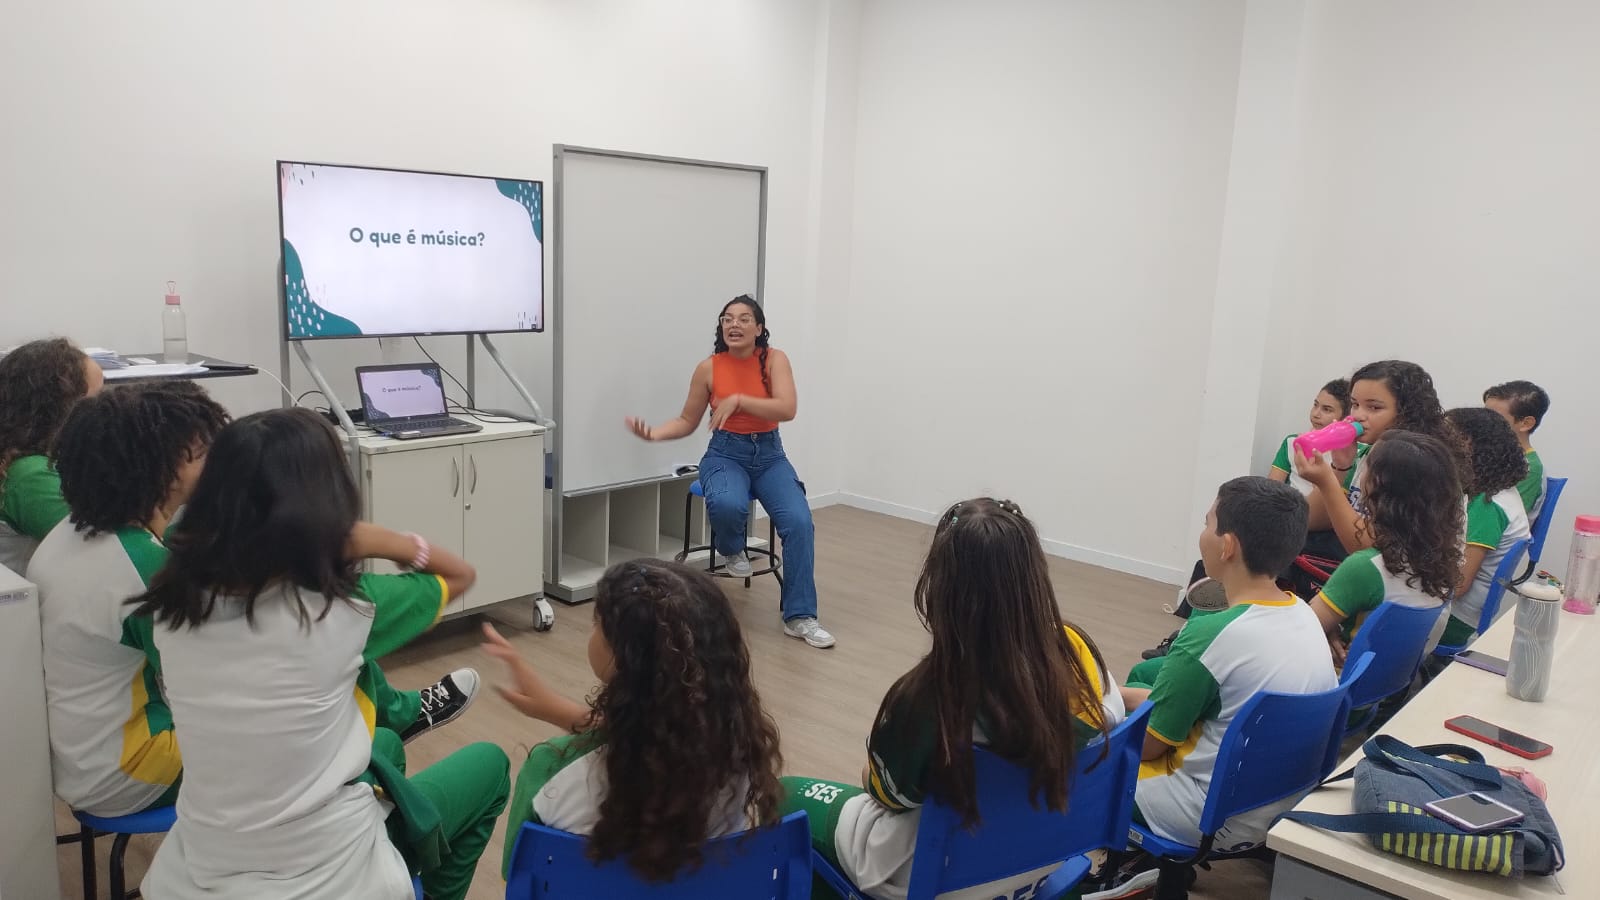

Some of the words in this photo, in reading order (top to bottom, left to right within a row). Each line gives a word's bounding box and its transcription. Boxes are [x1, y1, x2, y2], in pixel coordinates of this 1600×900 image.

[349, 227, 364, 243] O
[369, 232, 401, 248] que
[406, 229, 416, 244] é
[421, 230, 485, 247] música?
